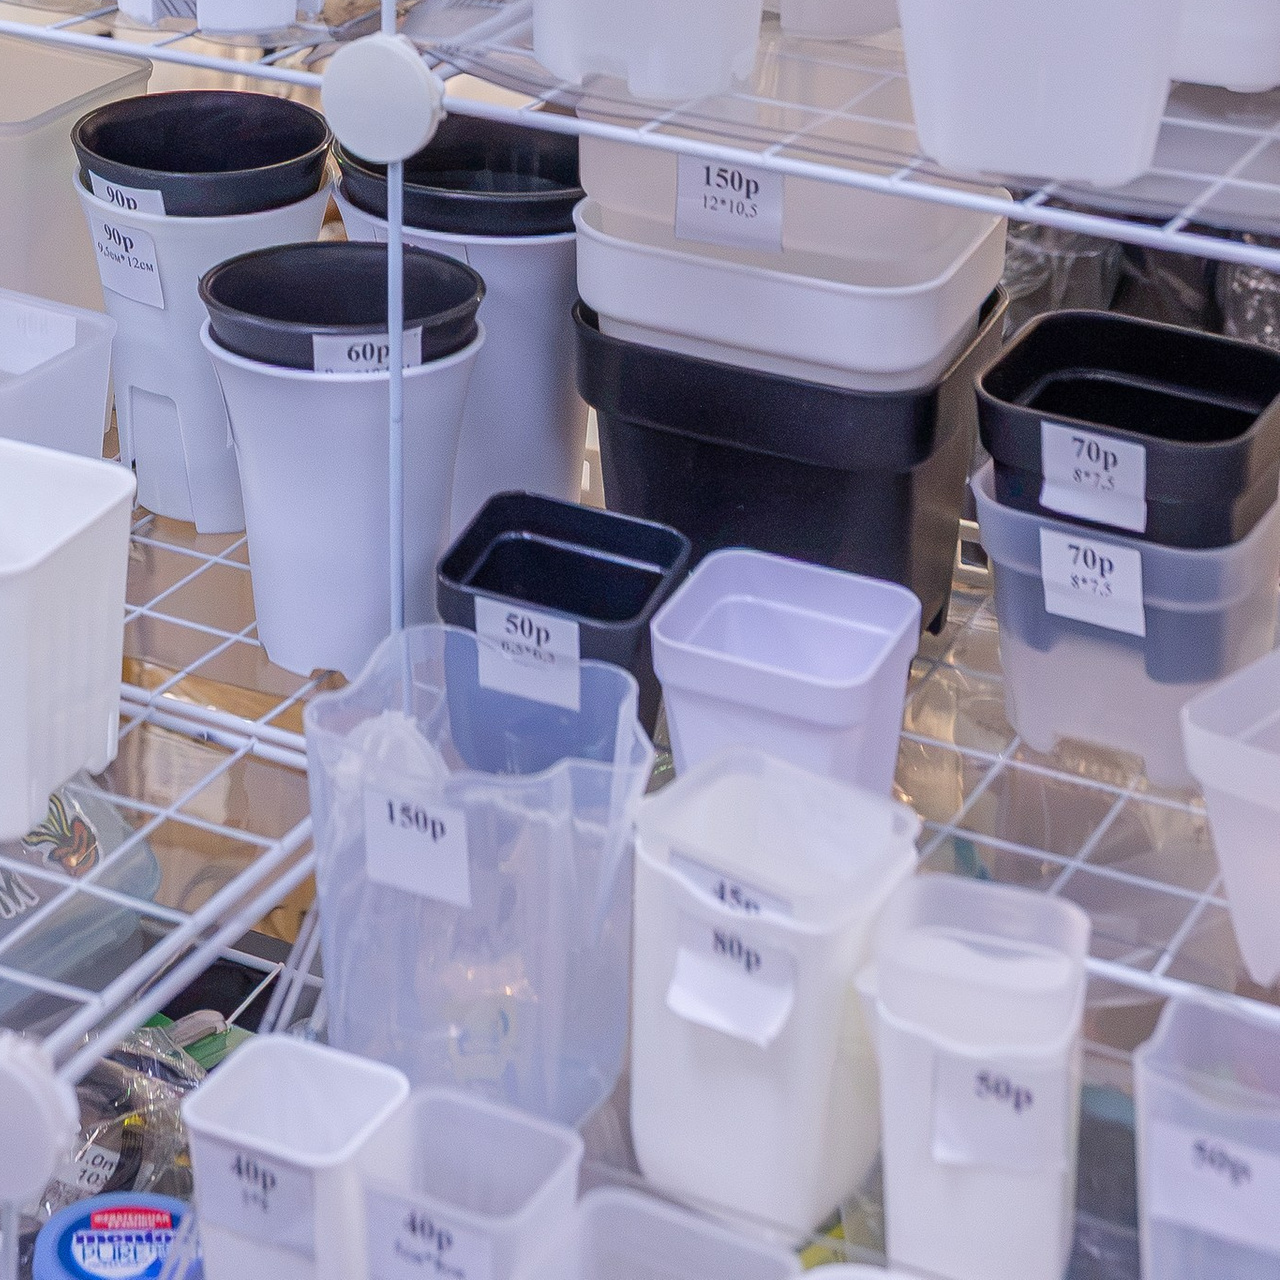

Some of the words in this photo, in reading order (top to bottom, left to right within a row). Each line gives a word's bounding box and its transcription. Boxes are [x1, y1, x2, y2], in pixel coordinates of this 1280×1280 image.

[106, 185, 138, 210] 90р
[704, 165, 759, 200] 150р
[103, 223, 134, 253] 90р
[347, 342, 389, 363] 60р
[1071, 436, 1117, 471] 70р
[1067, 543, 1113, 579] 70р
[504, 612, 550, 647] 50р
[387, 800, 446, 842] 150р
[230, 1154, 276, 1193] 40р
[405, 1210, 453, 1252] 40р
